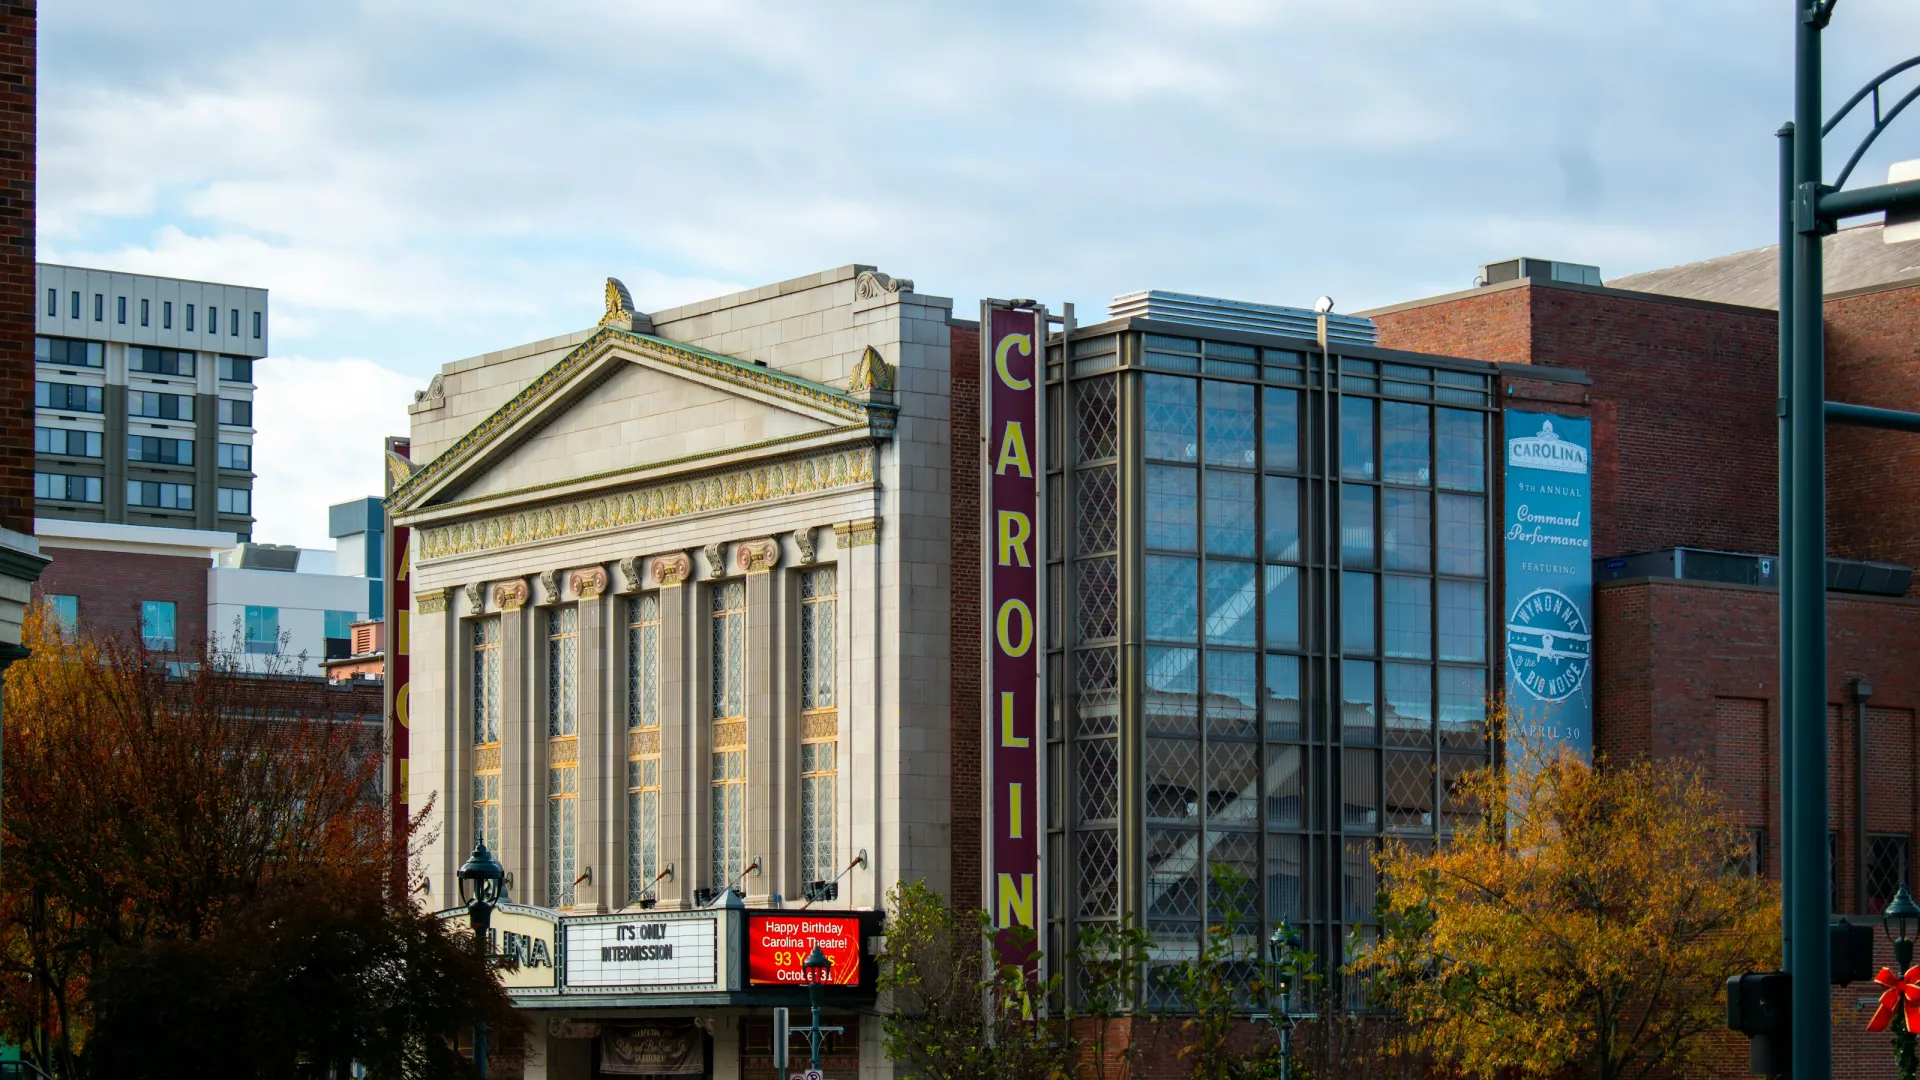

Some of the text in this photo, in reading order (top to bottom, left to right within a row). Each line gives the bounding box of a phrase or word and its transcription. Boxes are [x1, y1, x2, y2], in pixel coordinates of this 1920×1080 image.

[1512, 442, 1583, 464] CAROLINA
[1518, 482, 1582, 498] 9TH ANNUAL
[1517, 504, 1581, 527] Command
[1507, 523, 1589, 548] Performance
[1522, 561, 1576, 575] FEATURING
[1517, 595, 1580, 632] WYNONNA
[1515, 655, 1537, 667] & the
[995, 332, 1035, 1021] CAROLINA
[1525, 662, 1581, 696] BIG NOISE
[1520, 725, 1580, 740] APRIL 30
[616, 923, 667, 941] IT'S ONLY
[765, 921, 843, 936] Happy Birthday
[762, 936, 848, 949] Carolina Theatre!
[601, 944, 673, 963] INTERMISSION
[774, 951, 792, 966] 93
[776, 969, 818, 981] Octobe
